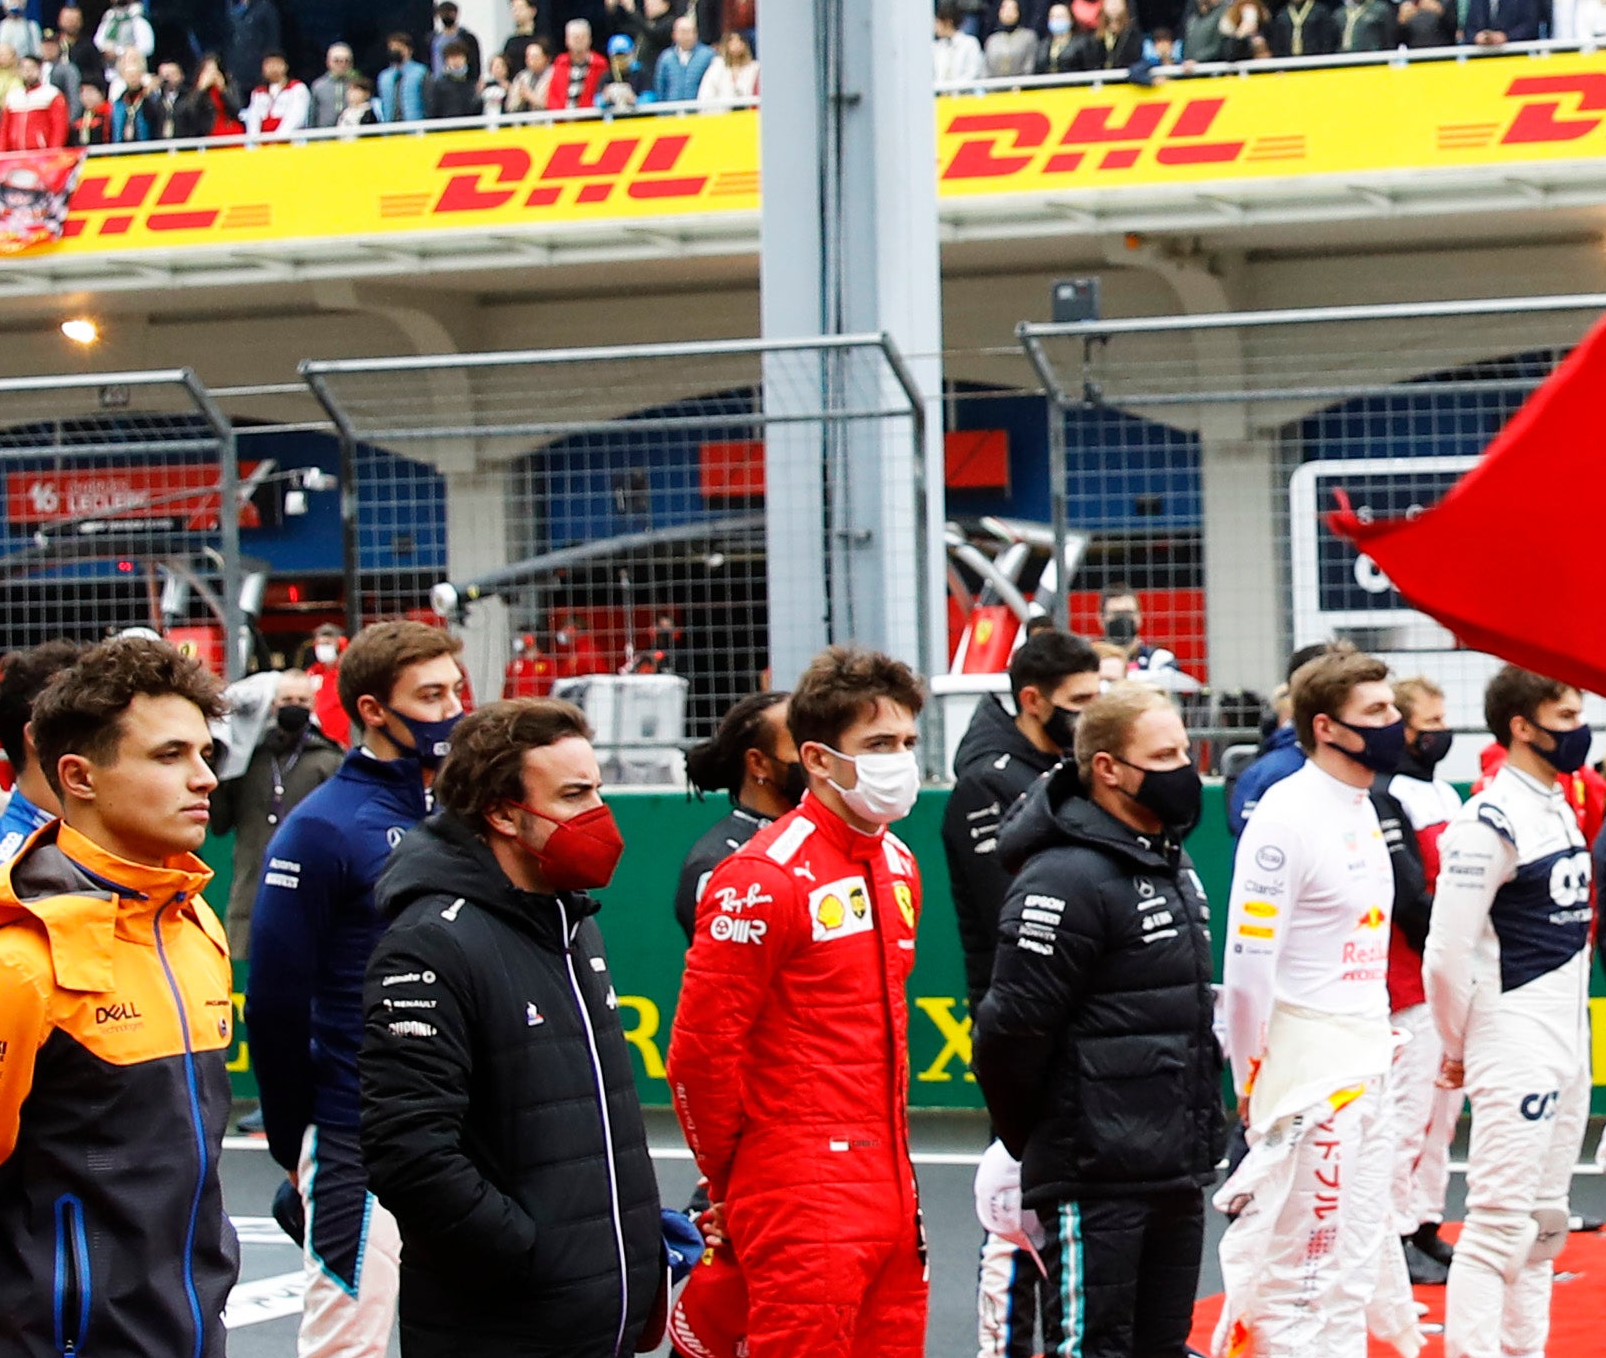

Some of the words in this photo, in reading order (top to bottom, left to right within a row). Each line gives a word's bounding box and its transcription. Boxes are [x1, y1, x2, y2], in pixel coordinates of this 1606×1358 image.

[433, 133, 709, 214] DHL
[942, 97, 1246, 180] DHL
[63, 169, 221, 237] HL
[96, 1002, 141, 1024] DELL
